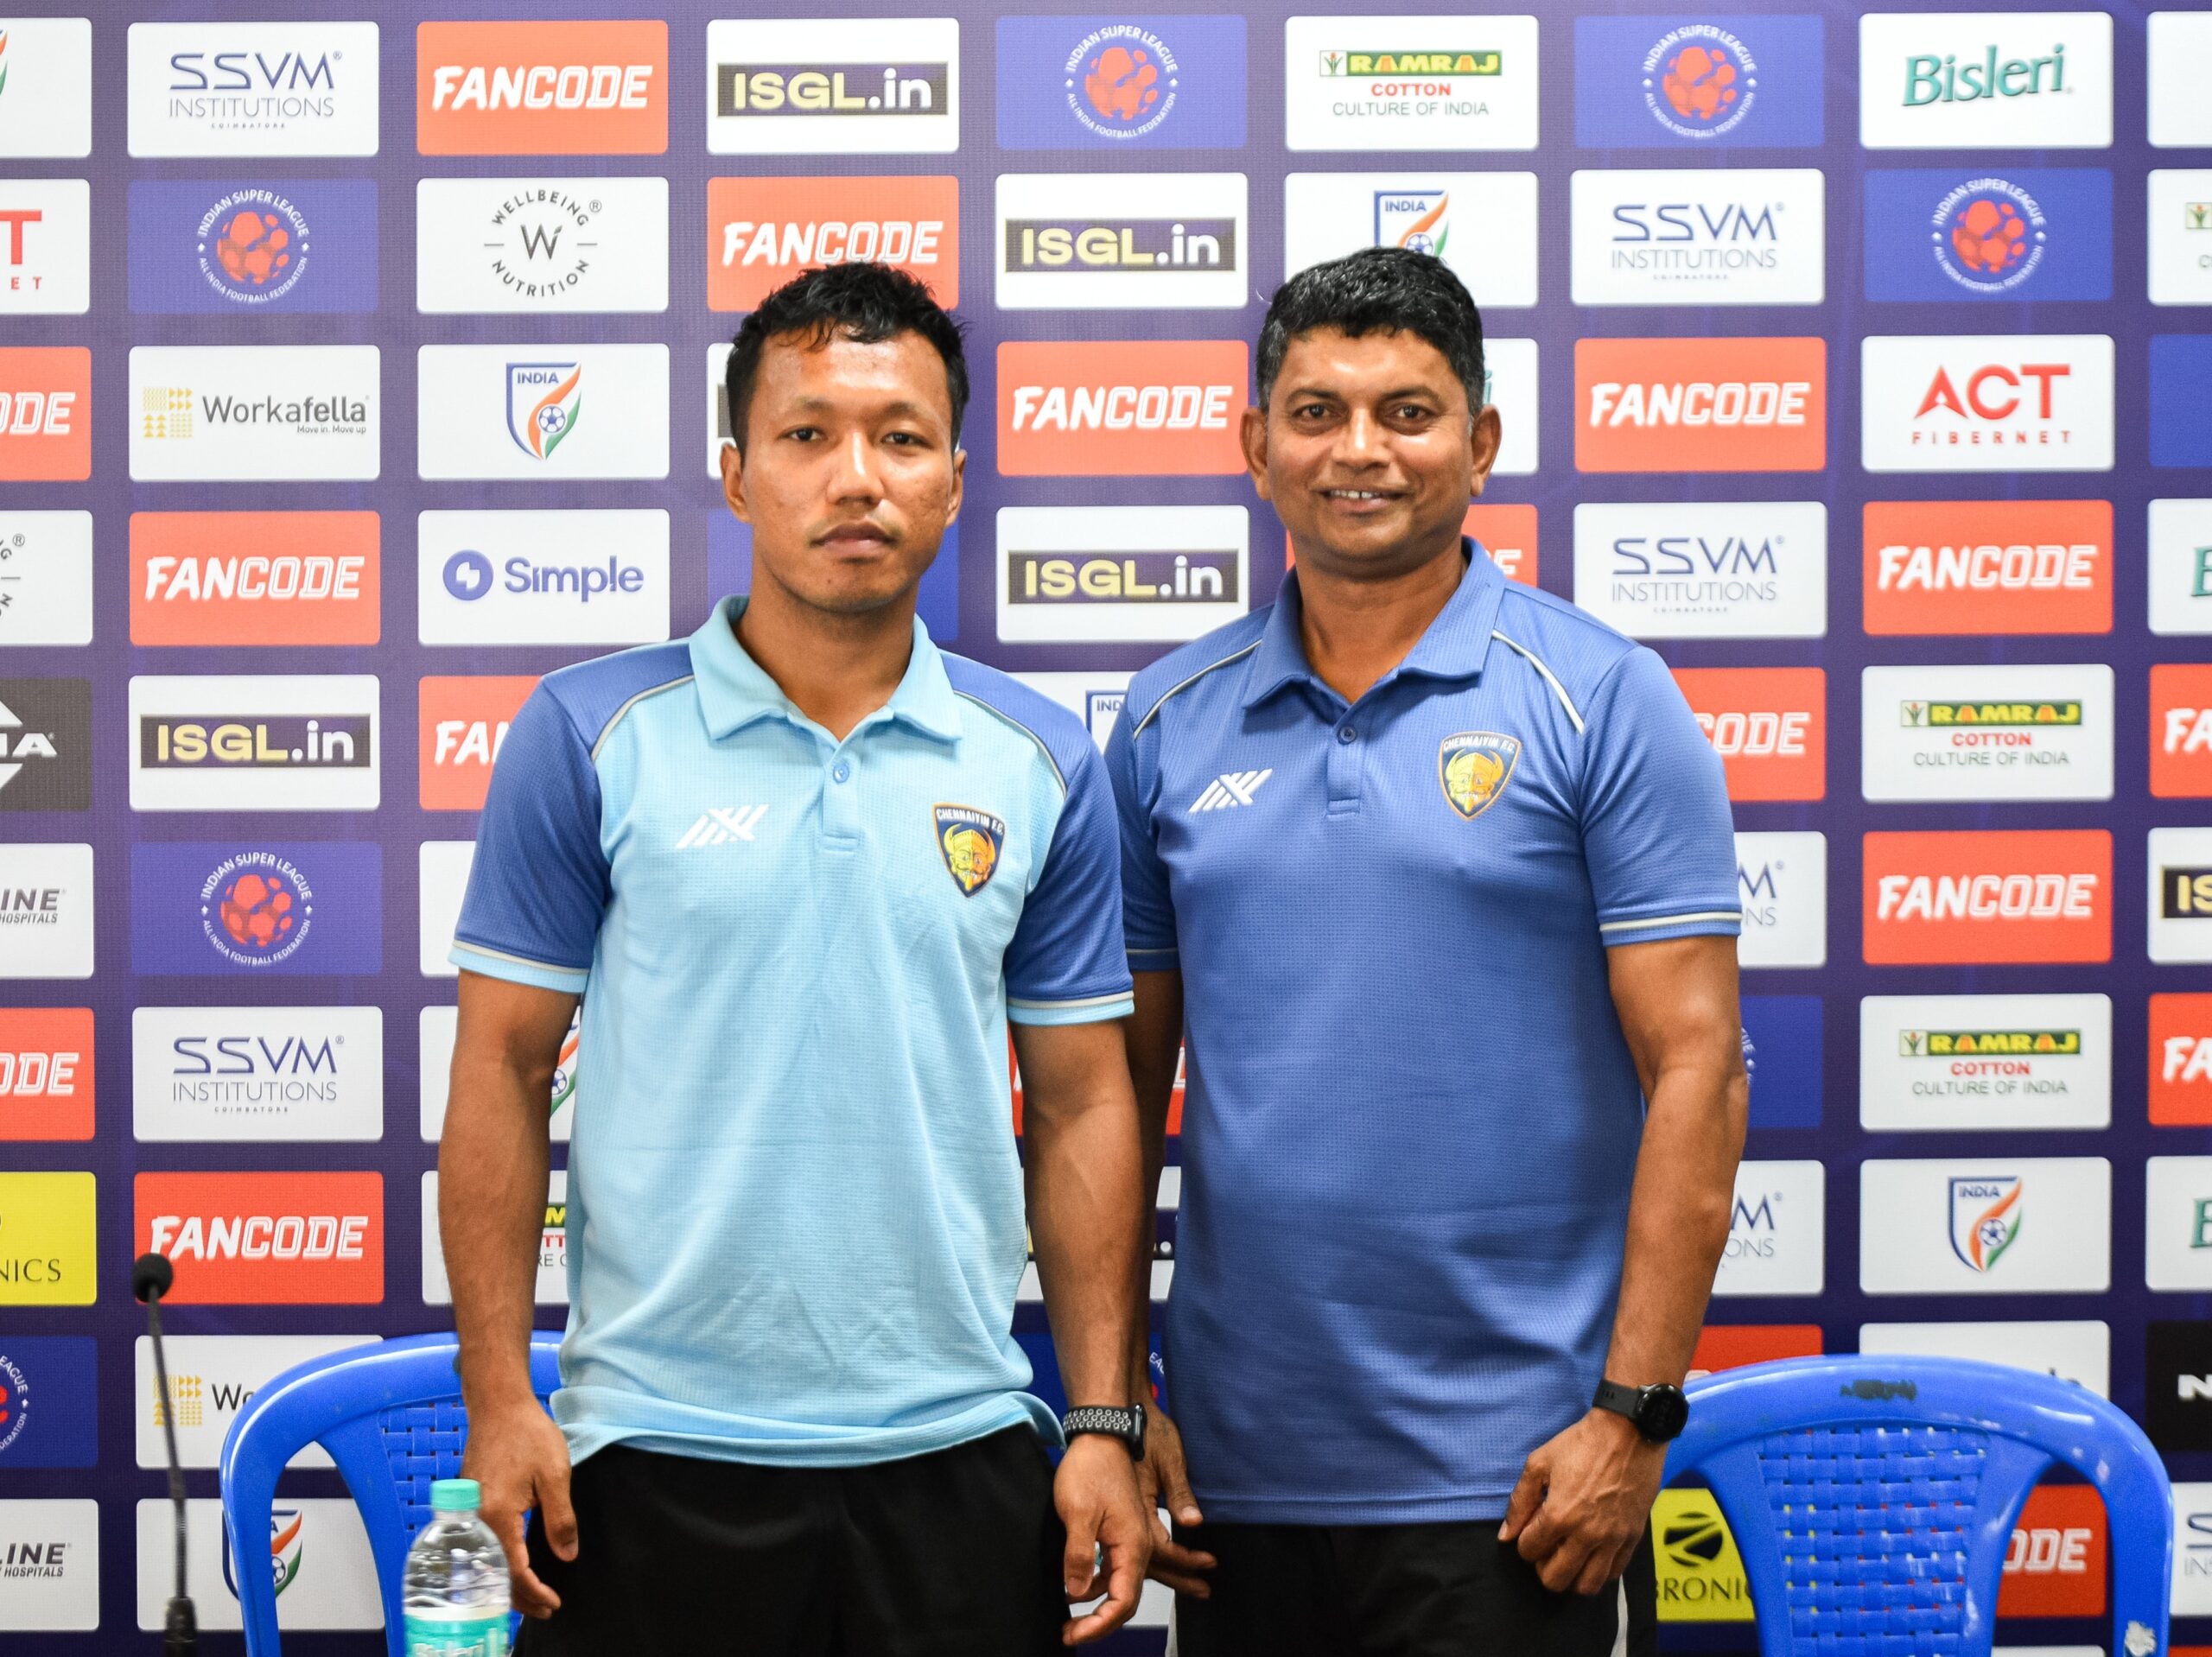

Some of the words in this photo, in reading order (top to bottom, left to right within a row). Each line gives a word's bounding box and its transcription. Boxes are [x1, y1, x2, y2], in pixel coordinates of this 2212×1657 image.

[1065, 31, 1101, 73] INDIAN
[1100, 24, 1141, 39] SUPER
[1141, 31, 1178, 73] LEAGUE
[1349, 54, 1499, 72] RAMRAJ
[1643, 31, 1680, 73] INDIAN
[1678, 24, 1719, 39] SUPER
[1719, 30, 1758, 73] LEAGUE
[432, 65, 653, 111] FANCODE
[734, 67, 932, 111] ISGL.in
[1370, 83, 1452, 96] COTTON
[1902, 44, 2065, 106] Bisleri
[169, 98, 334, 117] INSTITUTIONS
[1067, 92, 1078, 109] ALL
[1074, 107, 1095, 130] INDIA
[1094, 124, 1138, 138] FOOTBALL
[1138, 92, 1176, 135] FEDERATION
[1332, 102, 1410, 116] CULTURE
[1416, 102, 1438, 115] OF
[1445, 102, 1489, 115] INDIA
[197, 196, 232, 238] INDIAN
[232, 189, 273, 204] SUPER
[272, 195, 309, 238] LEAGUE
[491, 189, 589, 226] WELLBEING
[1384, 200, 1427, 212] INDIA
[722, 220, 943, 265] FANCODE
[1023, 224, 1220, 266] ISGL.in
[1612, 249, 1777, 268] INSTITUTIONS
[200, 257, 210, 273] ALL
[206, 271, 226, 295] INDIA
[226, 288, 269, 302] FOOTBALL
[269, 256, 308, 298] FEDERATION
[492, 259, 589, 297] NUTRITION
[517, 372, 559, 384] INDIA
[1913, 364, 2070, 420] ACT
[202, 395, 366, 423] Workafella
[1013, 385, 1232, 431] FANCODE
[1591, 382, 1811, 427] FANCODE
[356, 426, 366, 435] up
[1912, 432, 2070, 444] FIBERNET
[146, 556, 365, 600] FANCODE
[505, 555, 644, 603] Simple
[1026, 555, 1222, 597] ISGL.in
[1878, 544, 2096, 590] FANCODE
[1612, 581, 1777, 601] INSTITUTIONS
[1096, 699, 1122, 711] IND
[1930, 704, 2080, 722] RAMRAJ
[156, 721, 354, 763] ISGL.in
[1913, 752, 1990, 765] CULTURE
[1996, 752, 2018, 765] OF
[2024, 751, 2069, 765] INDIA
[1952, 733, 2032, 746] COTTON
[200, 859, 235, 899] INDIAN
[235, 852, 276, 867] SUPER
[276, 858, 312, 900] LEAGUE
[1877, 873, 2097, 919] FANCODE
[203, 919, 213, 936] ALL
[209, 933, 230, 957] INDIA
[230, 951, 272, 966] FOOTBALL
[272, 919, 311, 961] FEDERATION
[1929, 1032, 2078, 1052] RAMRAJ
[1911, 1081, 1988, 1095] CULTURE
[1994, 1081, 2018, 1094] OF
[2023, 1080, 2068, 1094] INDIA
[1950, 1062, 2031, 1076] COTTON
[174, 1081, 337, 1101] INSTITUTIONS
[1959, 1185, 2000, 1197] INDIA
[149, 1215, 368, 1260] FANCODE
[0, 1355, 29, 1395] EAGUE
[3, 1566, 64, 1578] HOSPITALS
